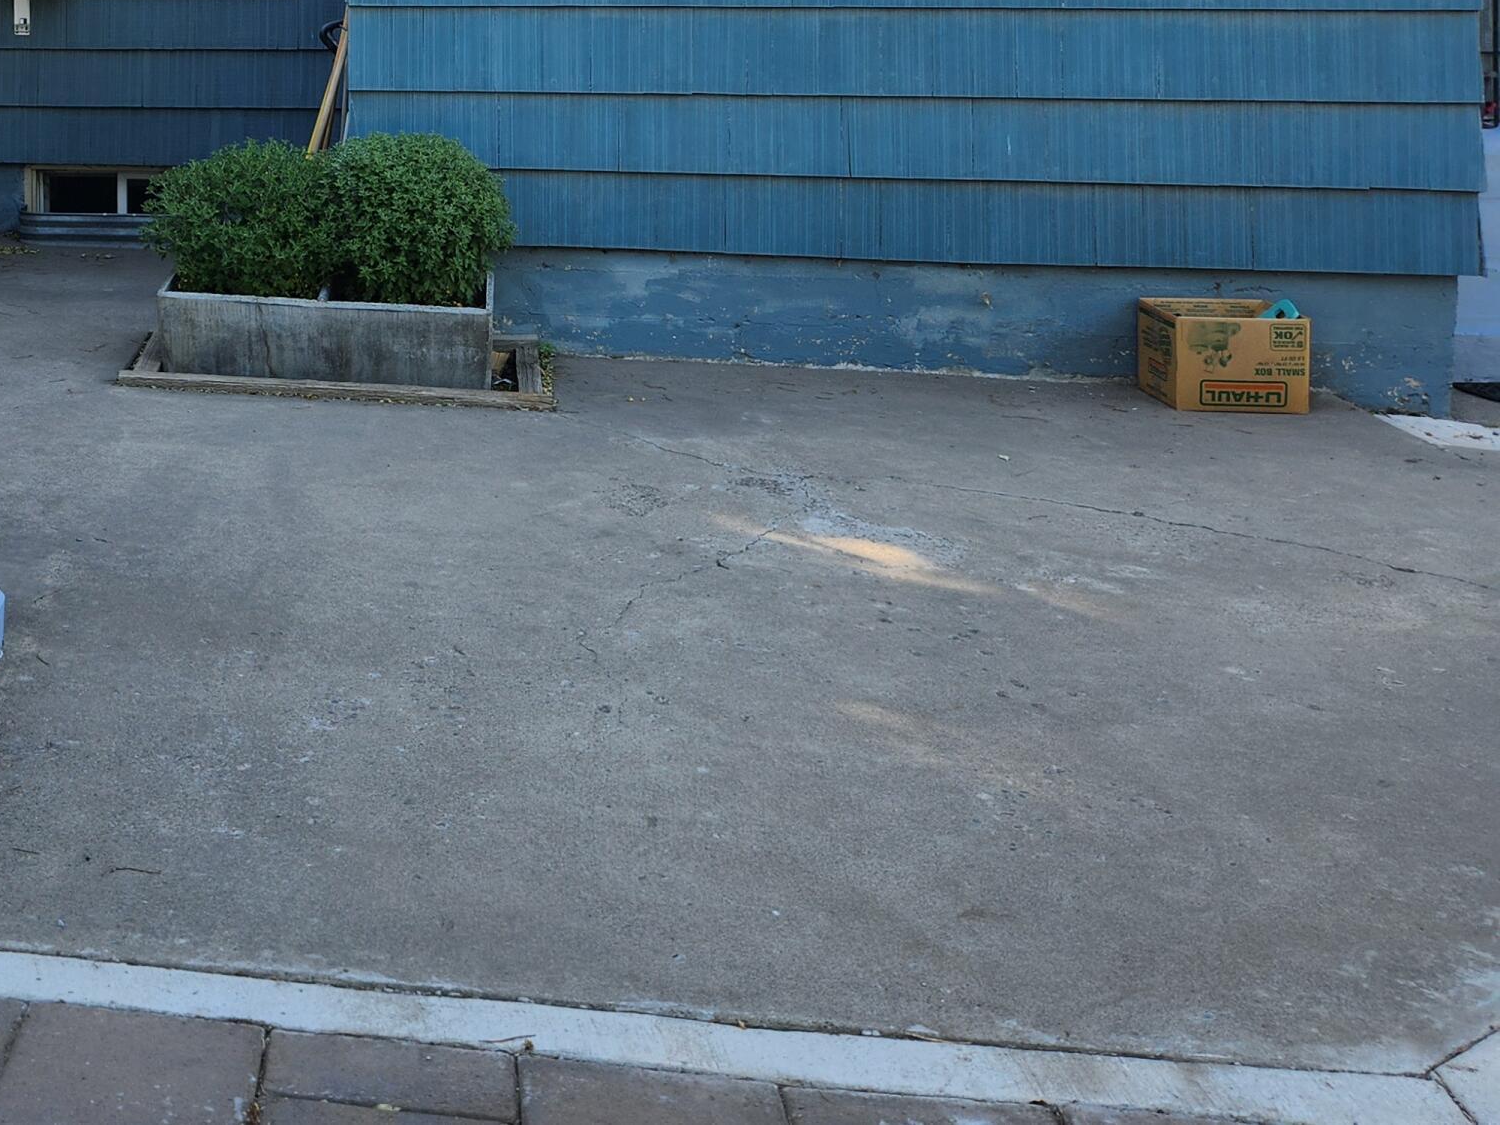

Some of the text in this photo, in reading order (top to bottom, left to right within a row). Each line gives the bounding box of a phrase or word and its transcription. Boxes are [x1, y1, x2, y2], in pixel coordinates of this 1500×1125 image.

[1254, 368, 1305, 376] SMALL BOX
[1206, 390, 1282, 403] U-HAUL
